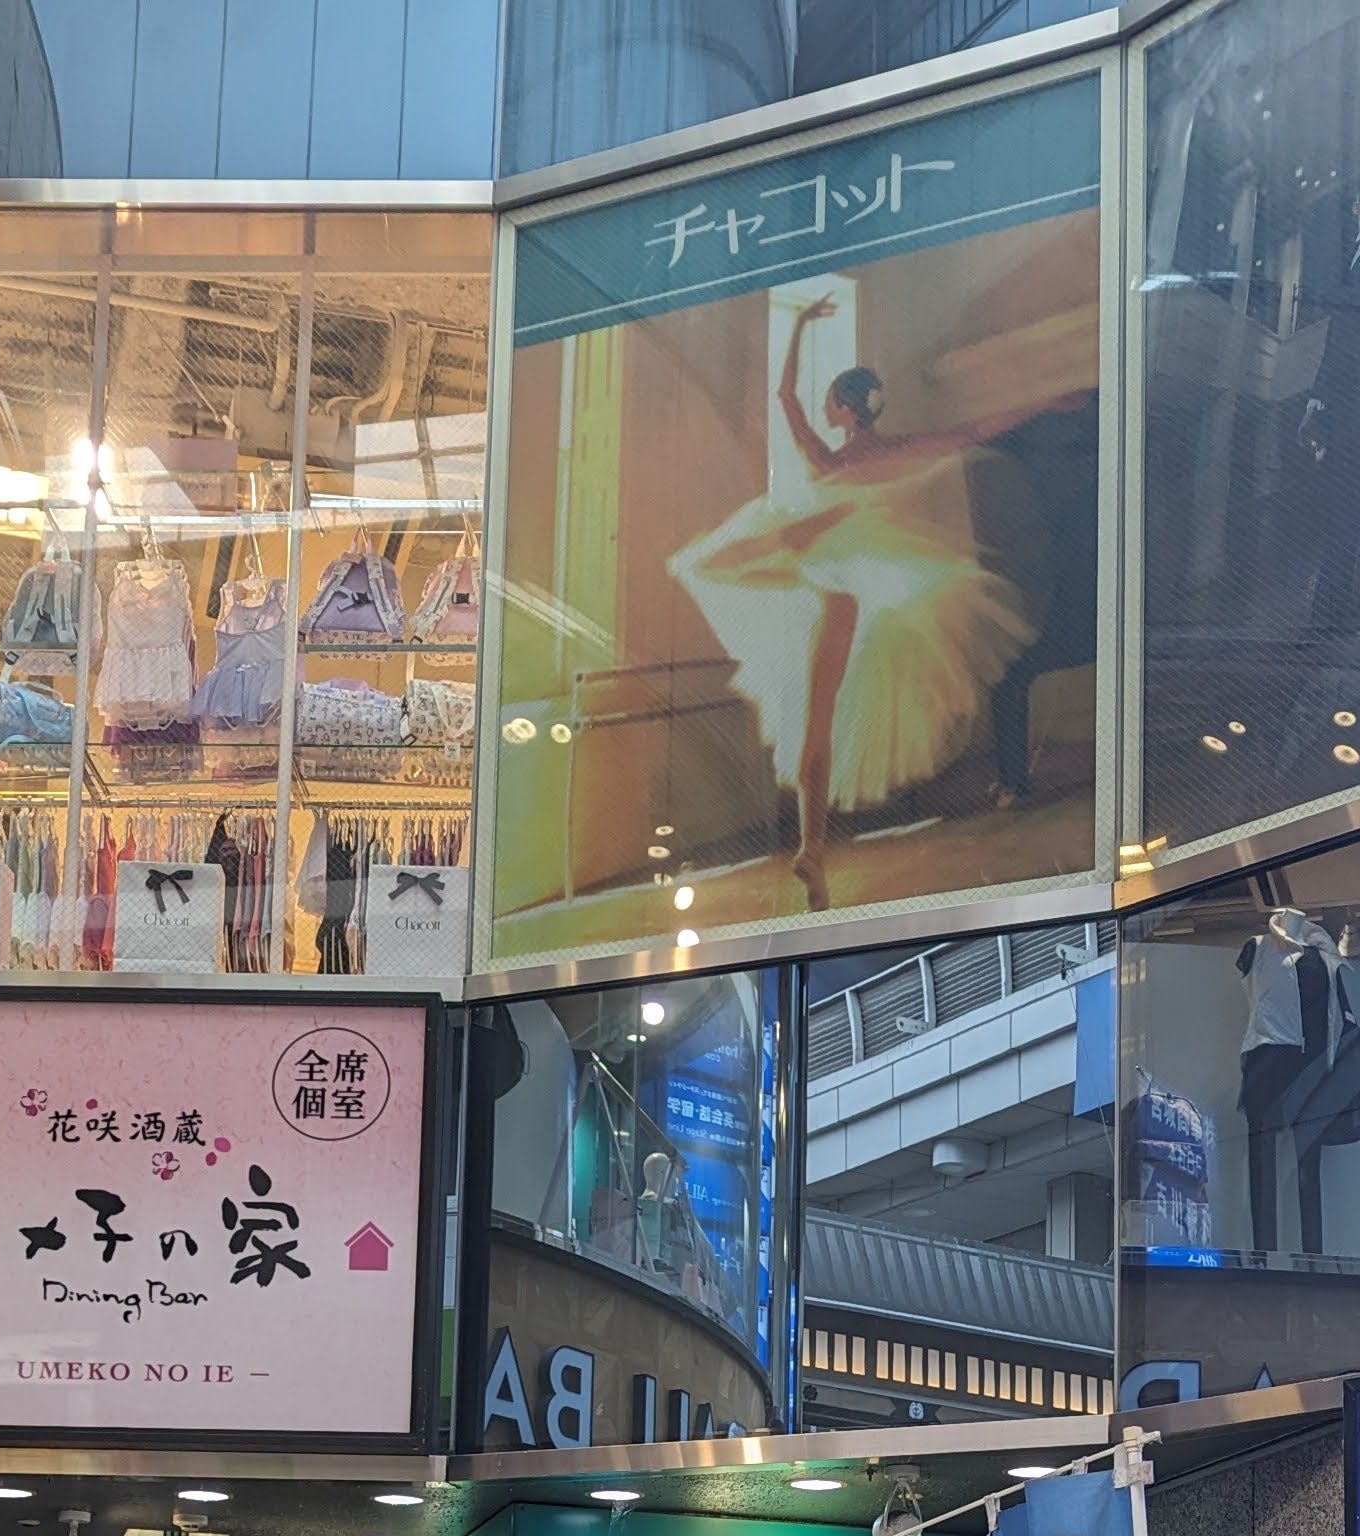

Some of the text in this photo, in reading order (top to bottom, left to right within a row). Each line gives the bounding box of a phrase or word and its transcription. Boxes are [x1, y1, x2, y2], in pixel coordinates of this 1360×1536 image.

[643, 153, 956, 269] チャコット
[144, 910, 190, 927] Chacott
[395, 915, 441, 931] Chacott
[294, 1048, 369, 1084] 全席
[292, 1086, 367, 1121] 個室
[47, 1109, 207, 1144] 花咲酒蔵
[43, 1278, 208, 1323] Dining Bar
[18, 1361, 235, 1383] UMEKO NO IE
